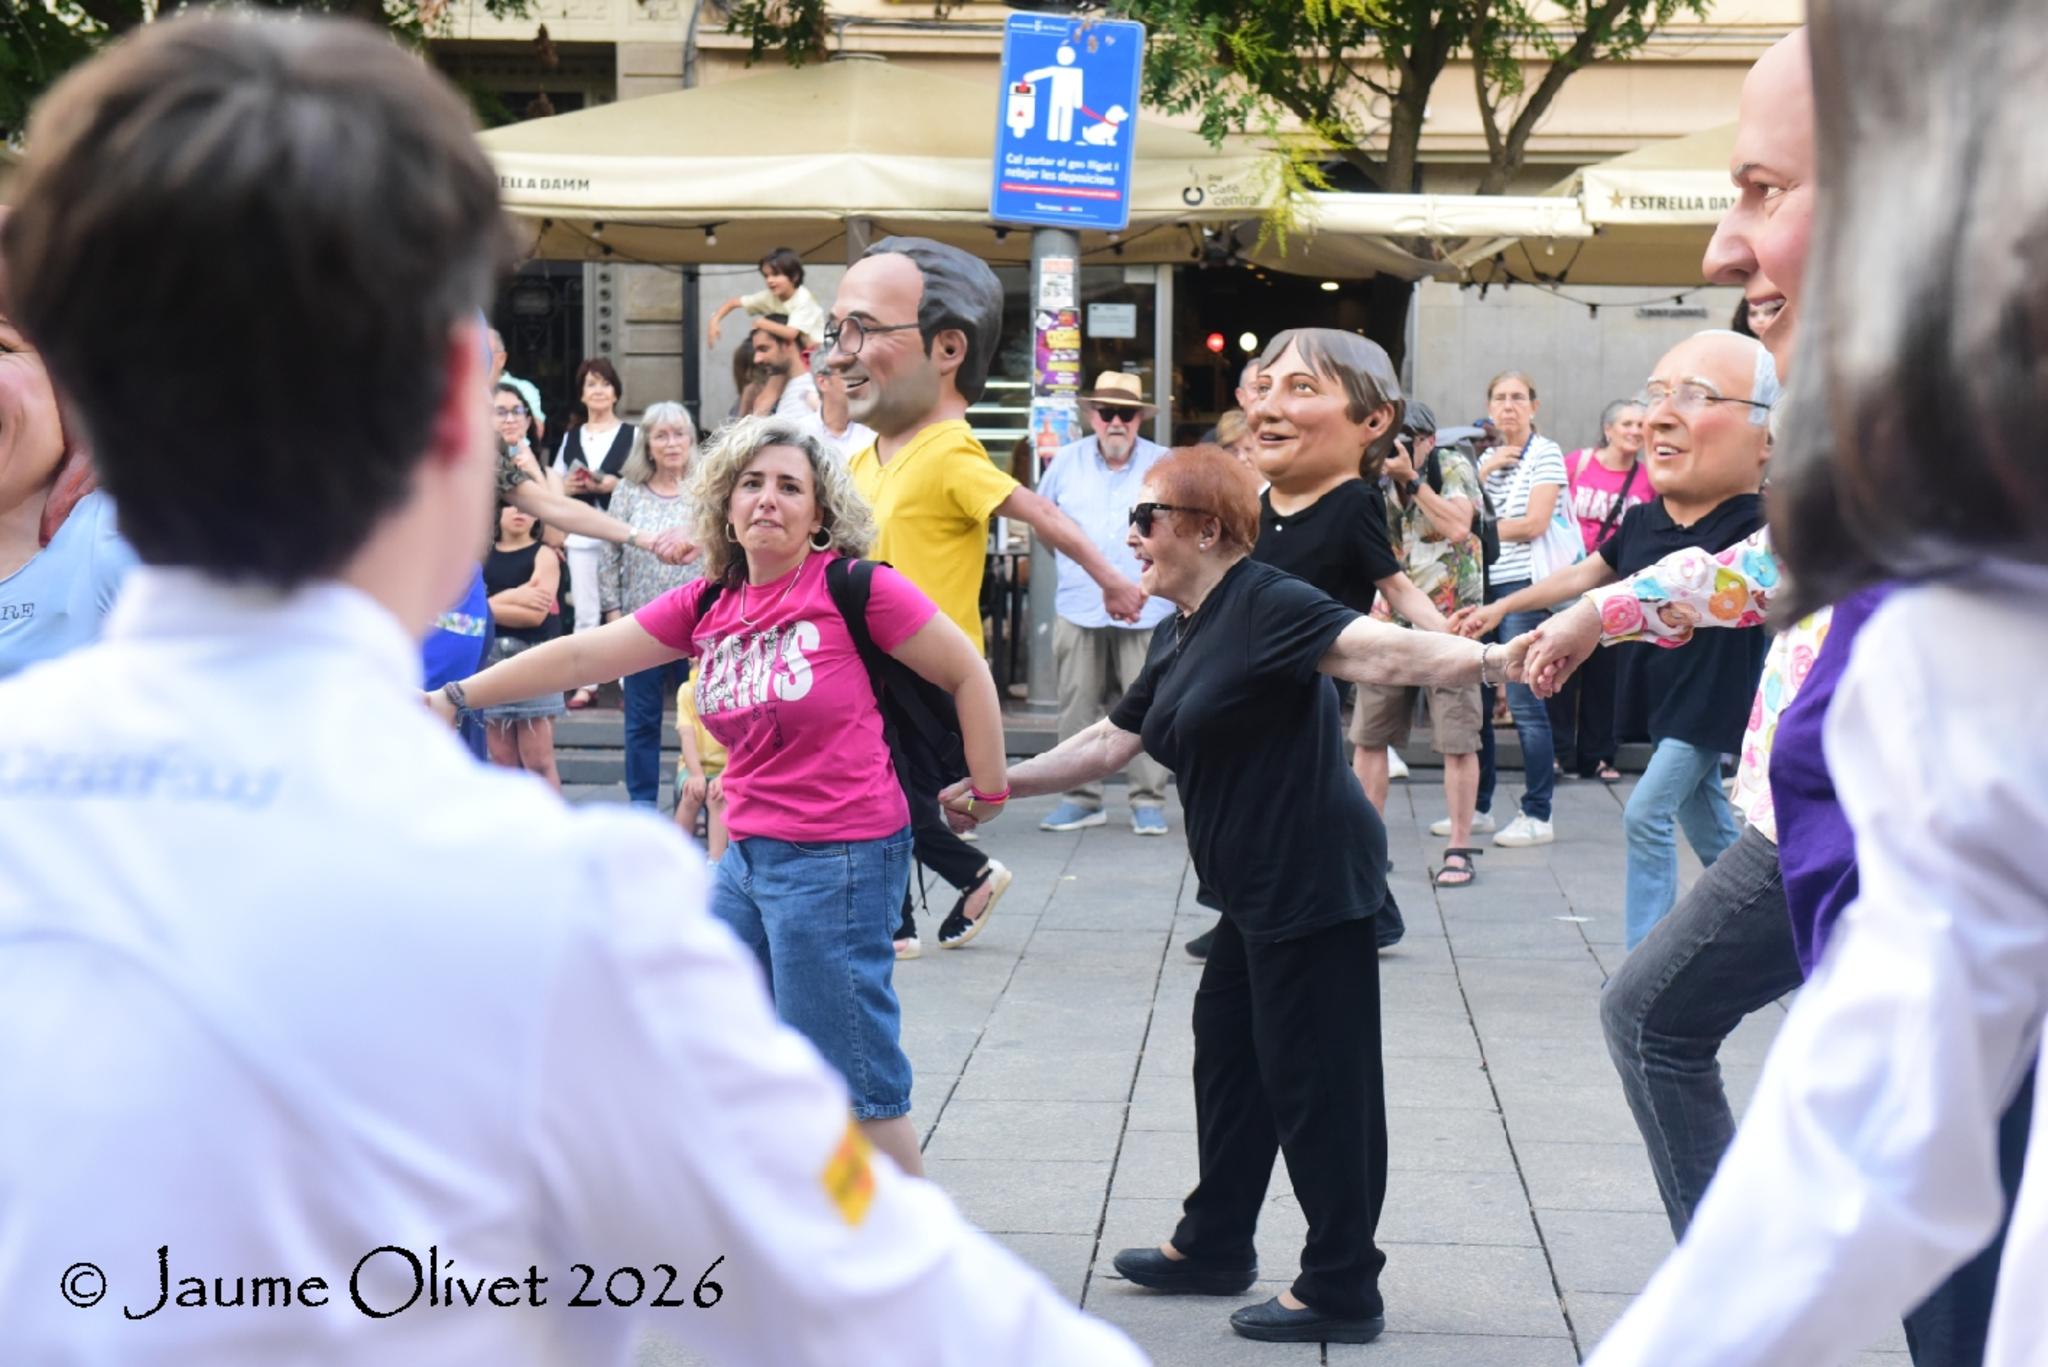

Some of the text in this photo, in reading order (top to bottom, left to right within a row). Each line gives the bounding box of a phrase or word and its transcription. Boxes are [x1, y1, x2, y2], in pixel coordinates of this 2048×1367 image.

[498, 175, 591, 191] ELLA DAMM
[1628, 195, 1705, 211] ESTRELLA
